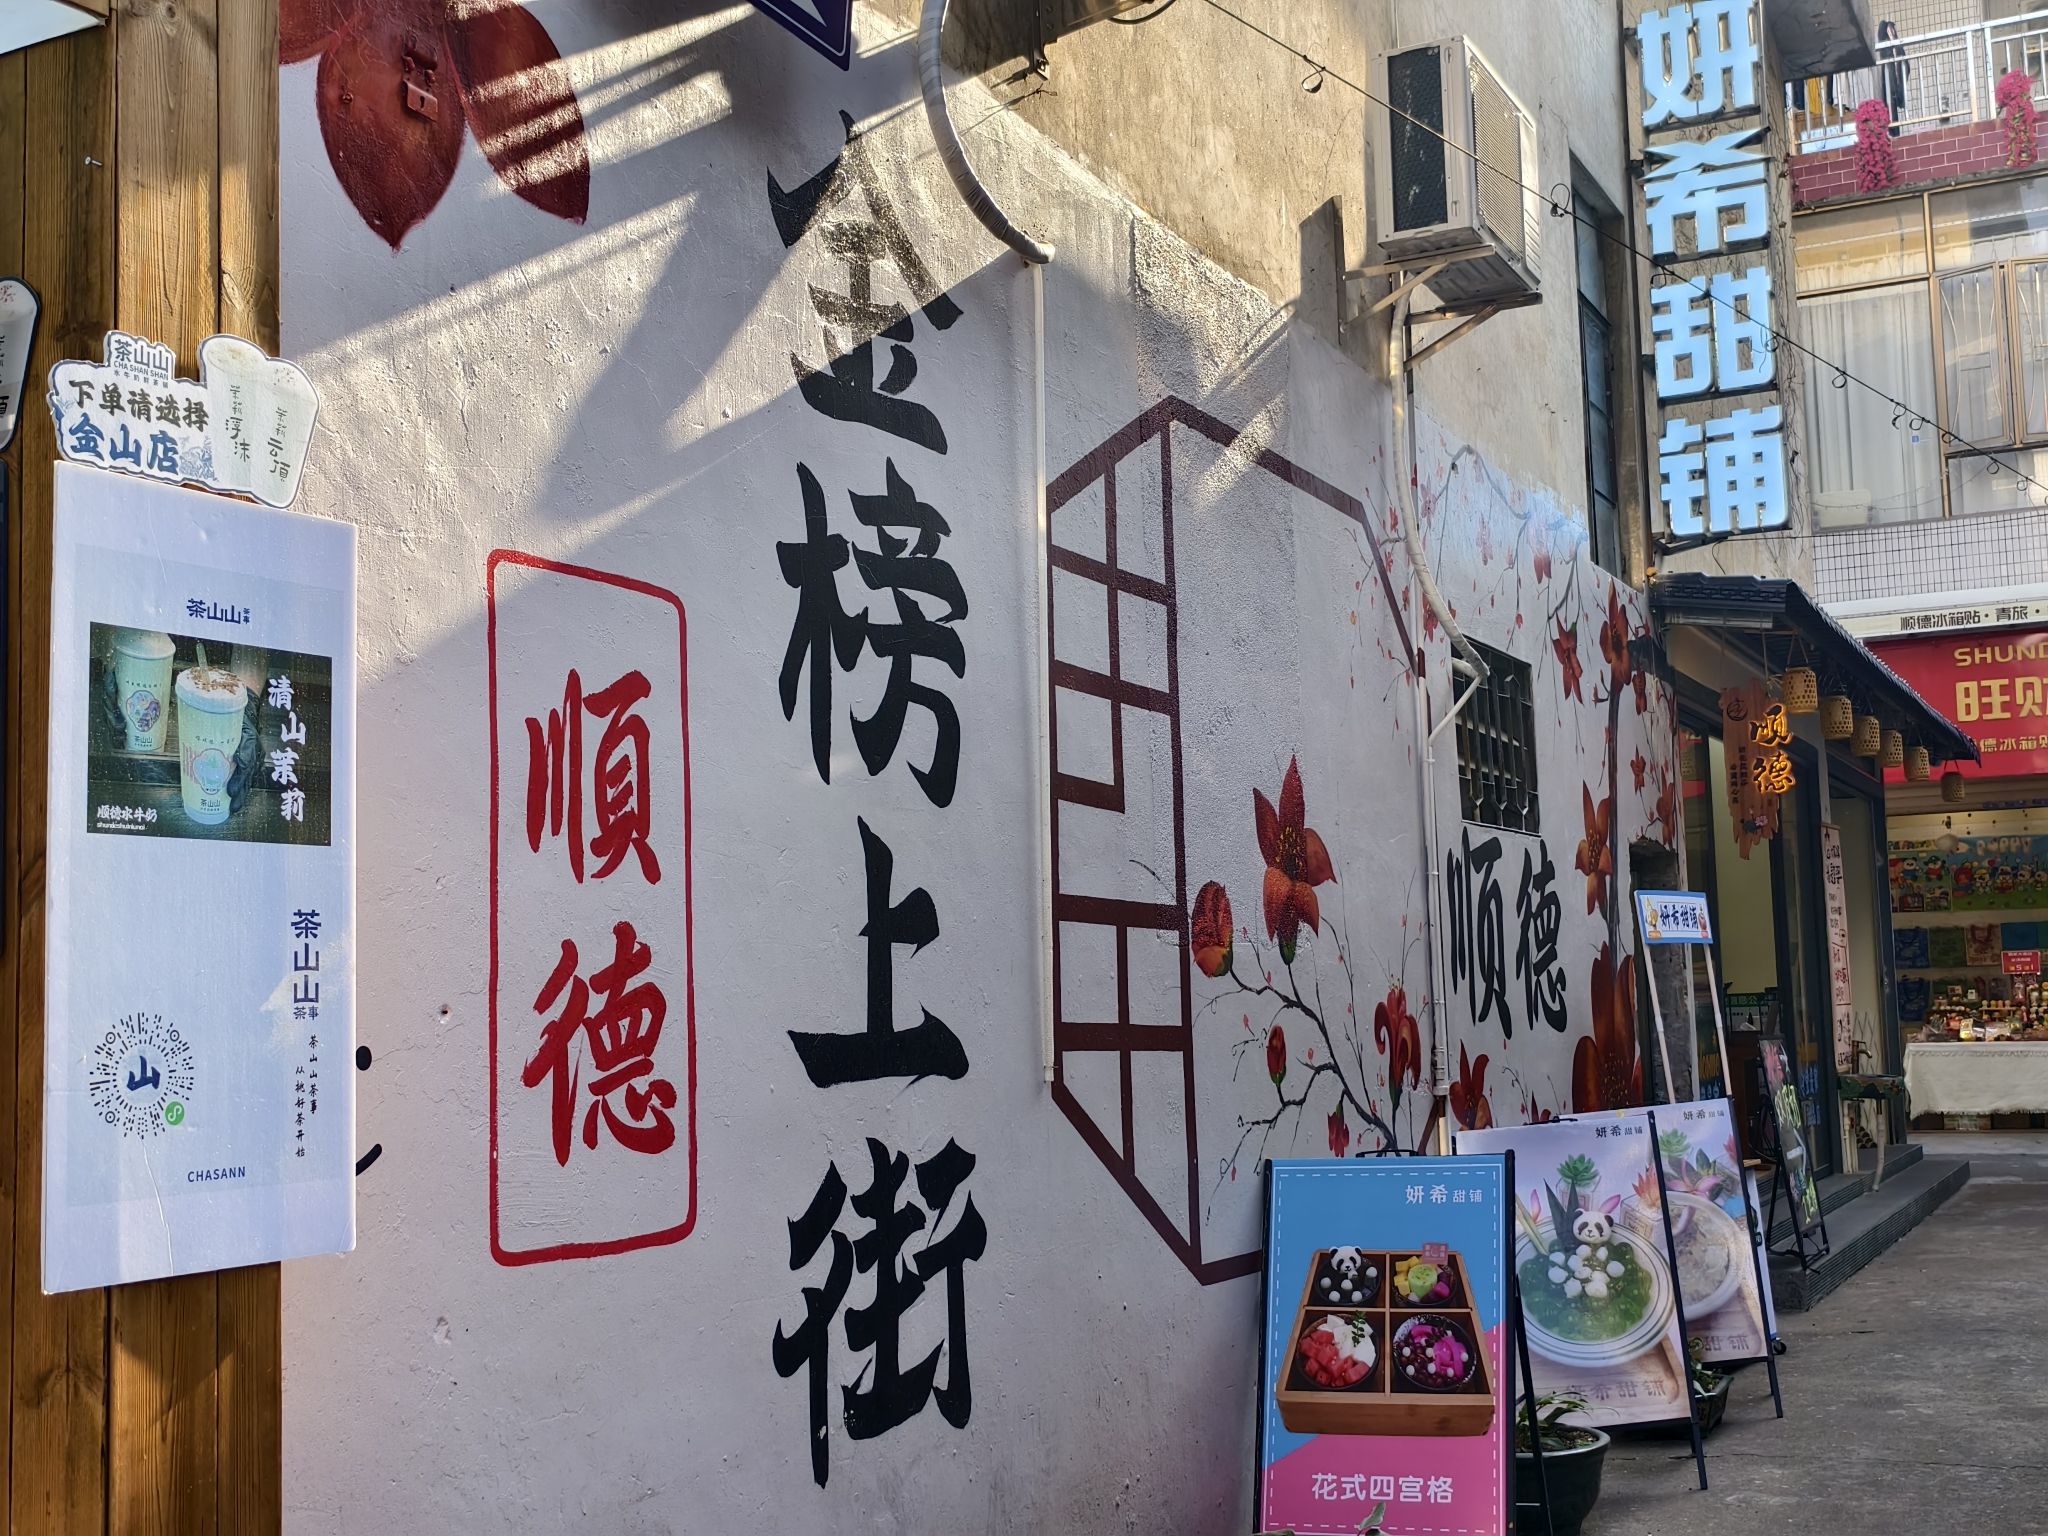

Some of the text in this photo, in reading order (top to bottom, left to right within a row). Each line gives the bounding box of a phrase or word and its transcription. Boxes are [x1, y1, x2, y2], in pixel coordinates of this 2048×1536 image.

[1637, 0, 1790, 538] 妍希甜铺
[114, 361, 169, 381] CHA SHAN SHAN
[115, 339, 168, 373] 茶山山
[69, 380, 209, 432] 下单请选择
[69, 412, 178, 476] 金山店
[186, 598, 241, 624] 茶山山
[767, 108, 987, 1487] 金榜上街
[291, 909, 322, 1020] 茶山山 茶事
[127, 1055, 161, 1092] 山
[309, 1034, 319, 1115] 茶山山茶事
[187, 1166, 246, 1183] CHASANN
[1406, 1184, 1483, 1204] 妍希甜铺
[1311, 1473, 1454, 1504] 花式四宫格
